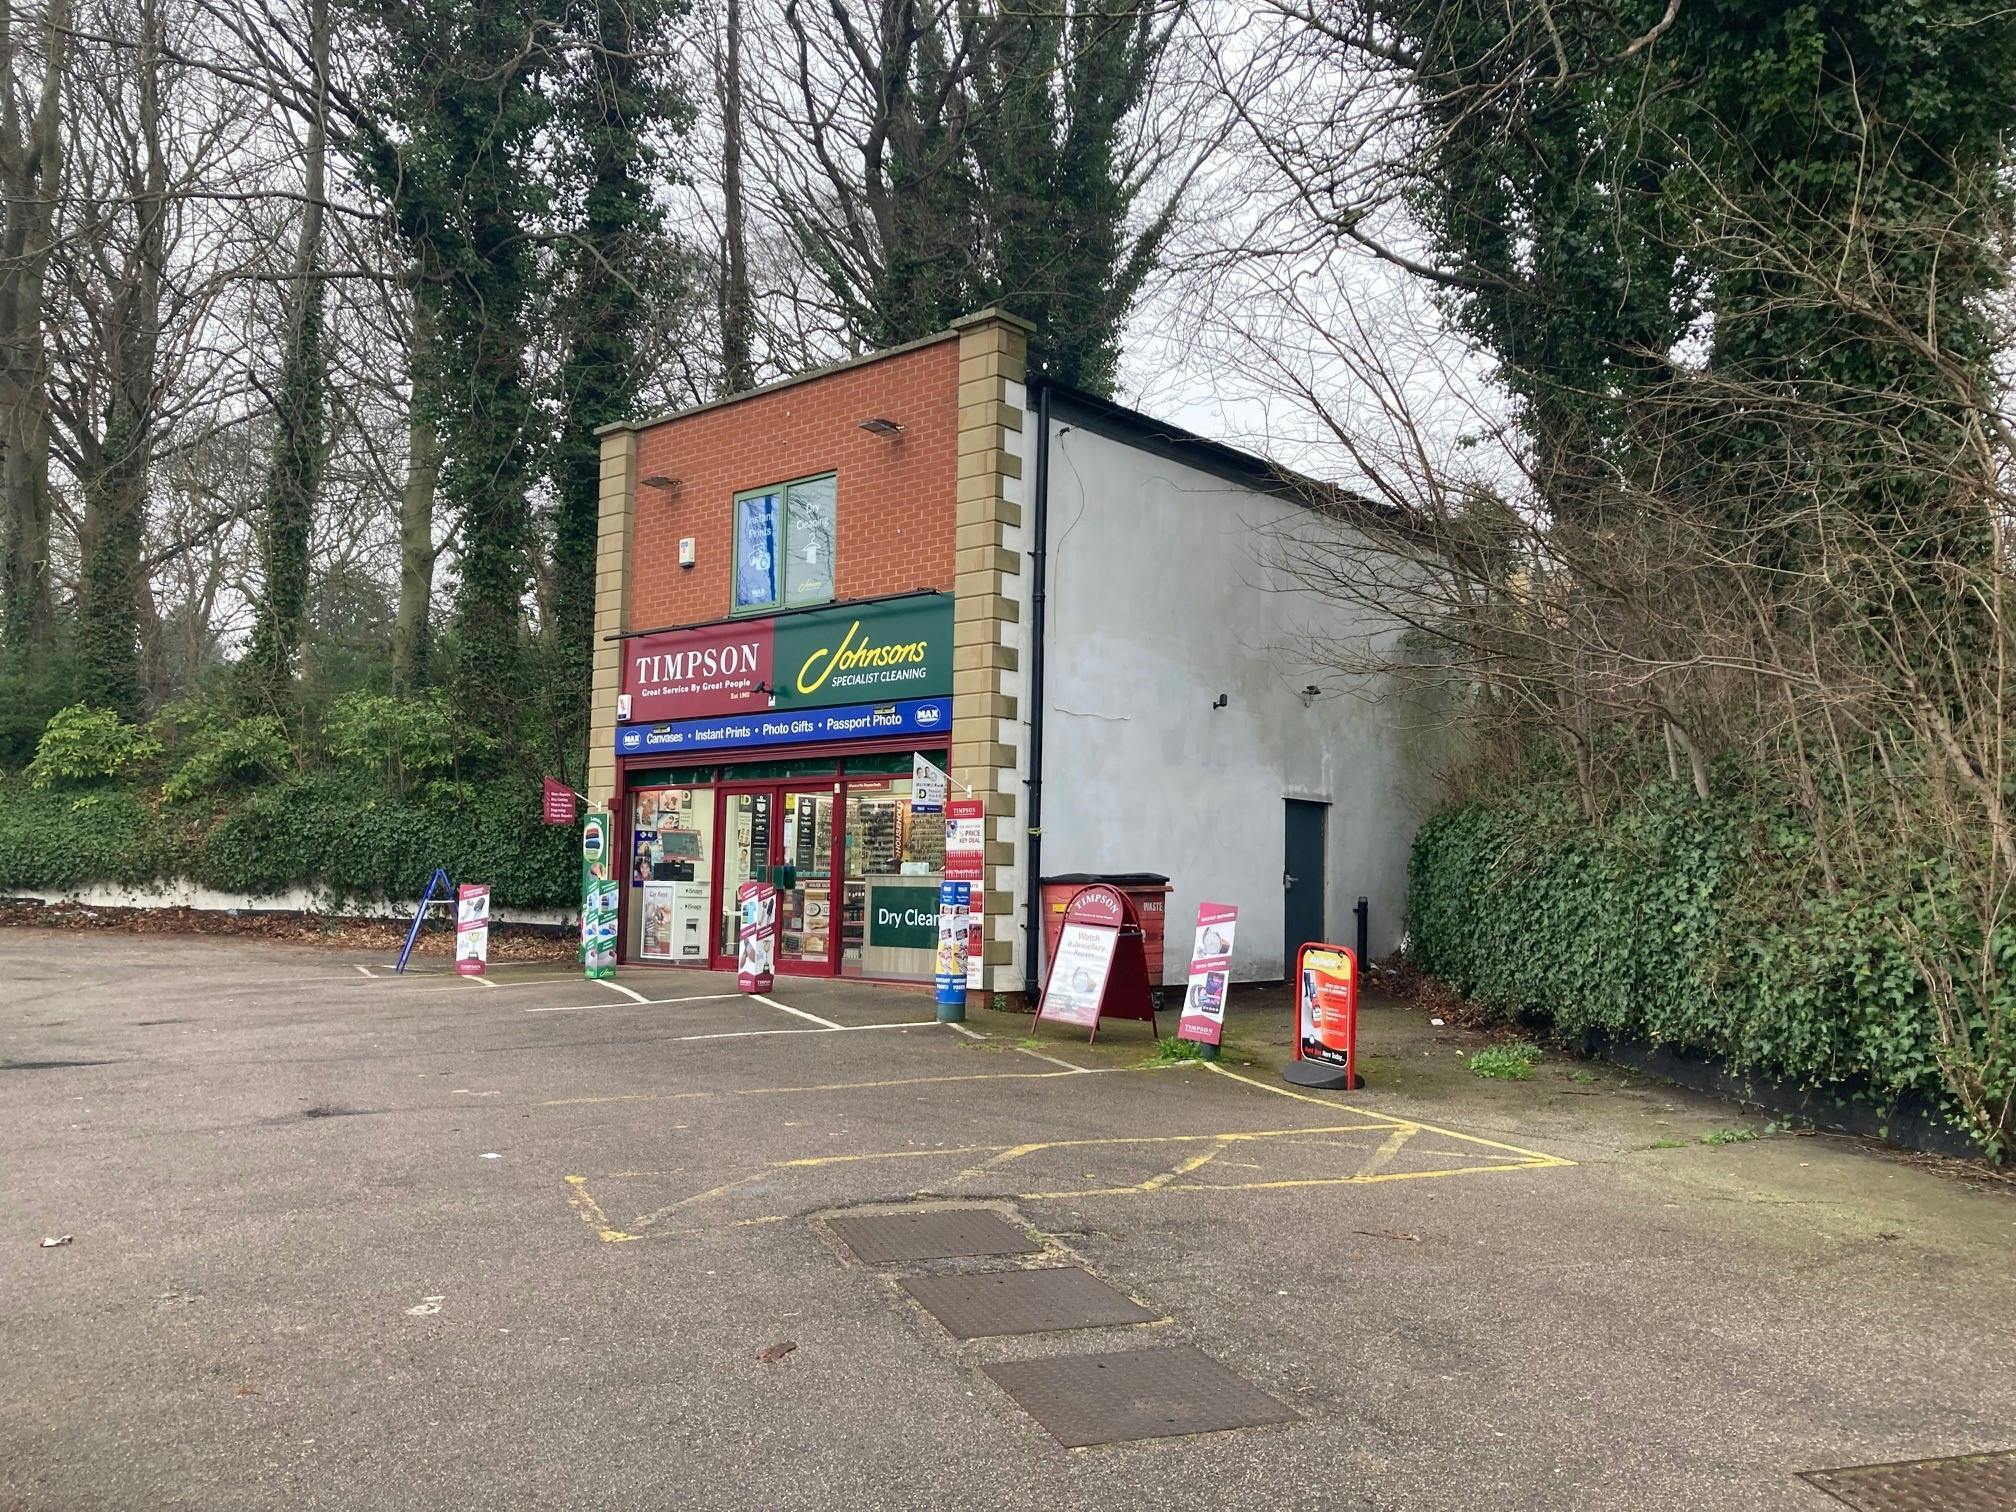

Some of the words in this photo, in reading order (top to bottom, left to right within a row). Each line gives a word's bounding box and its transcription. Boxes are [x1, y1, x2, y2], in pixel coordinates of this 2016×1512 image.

[806, 503, 820, 514] Dry
[747, 511, 774, 524] Instant
[796, 517, 829, 530] Cleaning
[749, 527, 772, 538] Prints
[636, 642, 760, 684] TIMPSON
[796, 620, 928, 694] Johnsons
[832, 672, 879, 687] SPECIALIST
[880, 667, 927, 682] CLEANING
[642, 686, 661, 697] Great
[662, 684, 689, 695] Service
[690, 683, 700, 694] By
[702, 681, 723, 691] Great
[725, 678, 751, 690] People
[624, 734, 640, 743] MAX
[646, 733, 683, 744] Canvases
[695, 728, 724, 740] Instant
[725, 726, 751, 738] Prints
[762, 723, 789, 735] Photo
[791, 720, 814, 733] Gifts
[826, 714, 871, 731] Passport
[872, 714, 902, 726] Photo
[916, 708, 939, 719] MAX
[895, 800, 903, 854] HOUSEHOLD
[1074, 894, 1119, 914] TIMPSON
[1143, 902, 1163, 912] WASTE
[878, 908, 902, 928] Dry
[904, 908, 940, 926] Clean
[1079, 932, 1101, 941] Watch
[1073, 942, 1106, 952] Jewellery
[1185, 1024, 1213, 1033] TIMPSON
